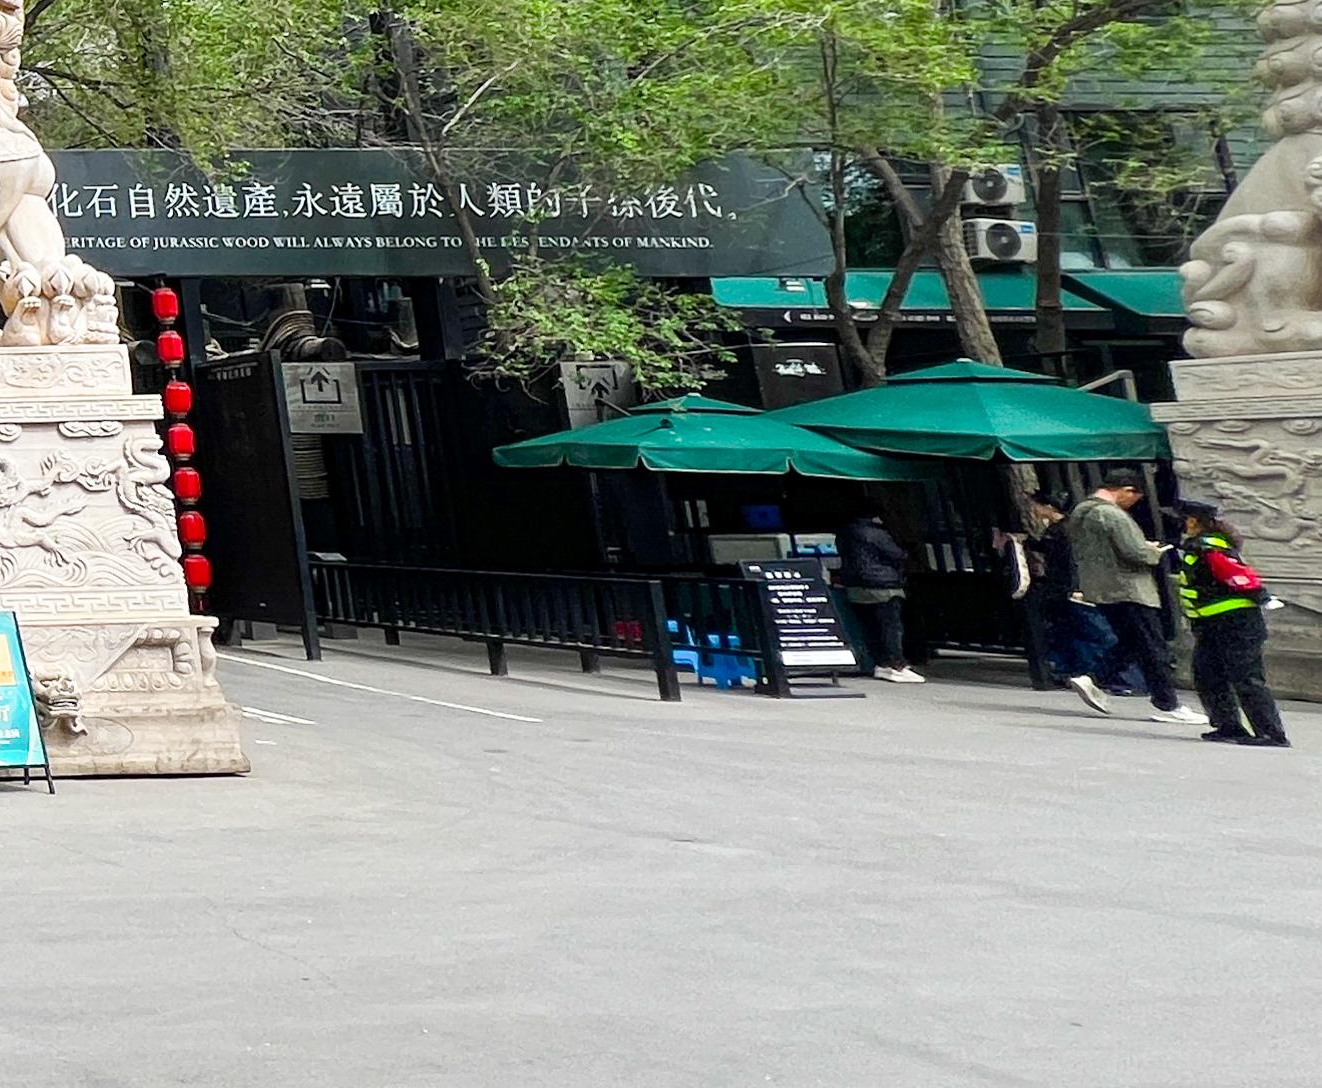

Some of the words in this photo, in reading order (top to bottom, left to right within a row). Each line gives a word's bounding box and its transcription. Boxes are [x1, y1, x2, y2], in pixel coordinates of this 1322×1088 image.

[129, 237, 151, 249] OF
[153, 237, 219, 250] JURASSIC
[221, 237, 269, 249] WOOD
[272, 237, 310, 249] WILL
[312, 237, 372, 249] ALWAYS
[376, 237, 437, 248] BELONG
[440, 237, 463, 248] TO
[612, 237, 633, 248] OF
[637, 236, 714, 248] MANKIND.
